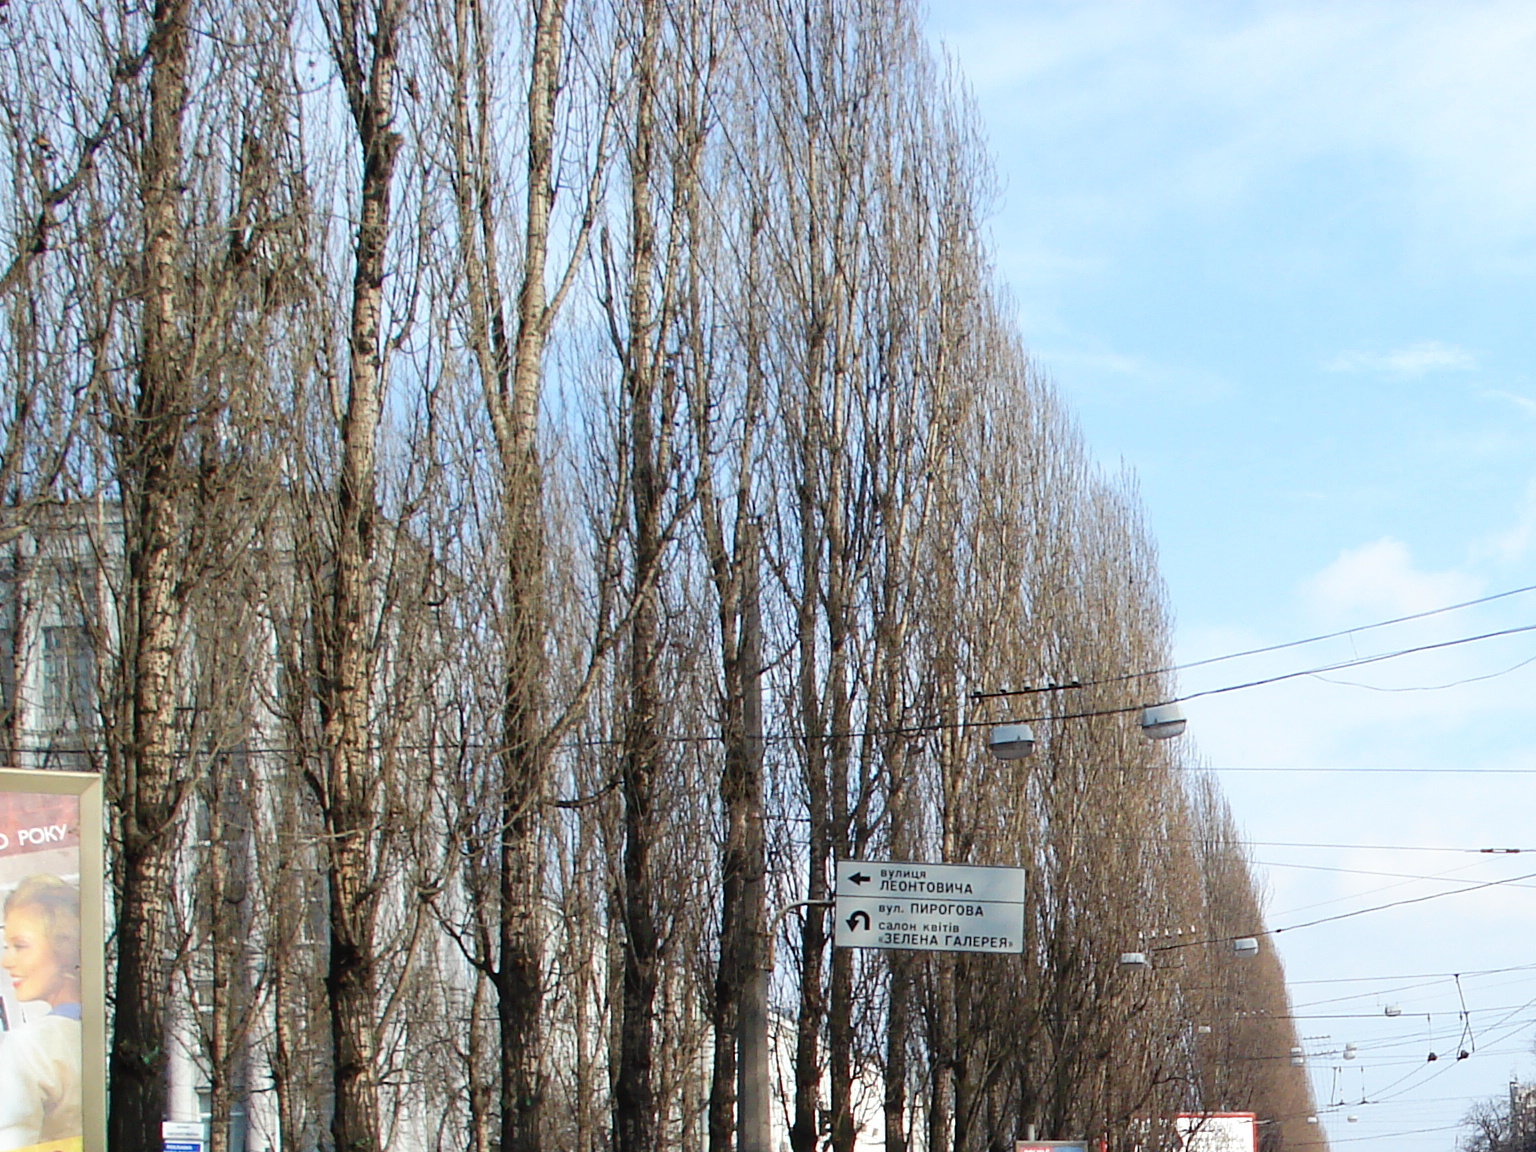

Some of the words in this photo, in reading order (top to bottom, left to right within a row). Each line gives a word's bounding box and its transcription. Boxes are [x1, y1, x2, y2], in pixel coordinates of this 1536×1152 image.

[17, 824, 67, 846] РОКУ
[880, 869, 927, 880] вулиця
[880, 880, 973, 894] ЛЕОНТОВИЧА
[878, 904, 905, 916] вул.
[910, 903, 985, 917] ПИРОГОВА
[878, 921, 917, 932] салон
[922, 922, 960, 933] квітів
[878, 932, 939, 946] «ЗЕЛЕНА
[945, 935, 1014, 949] ГАЛЕРЕЯ»
